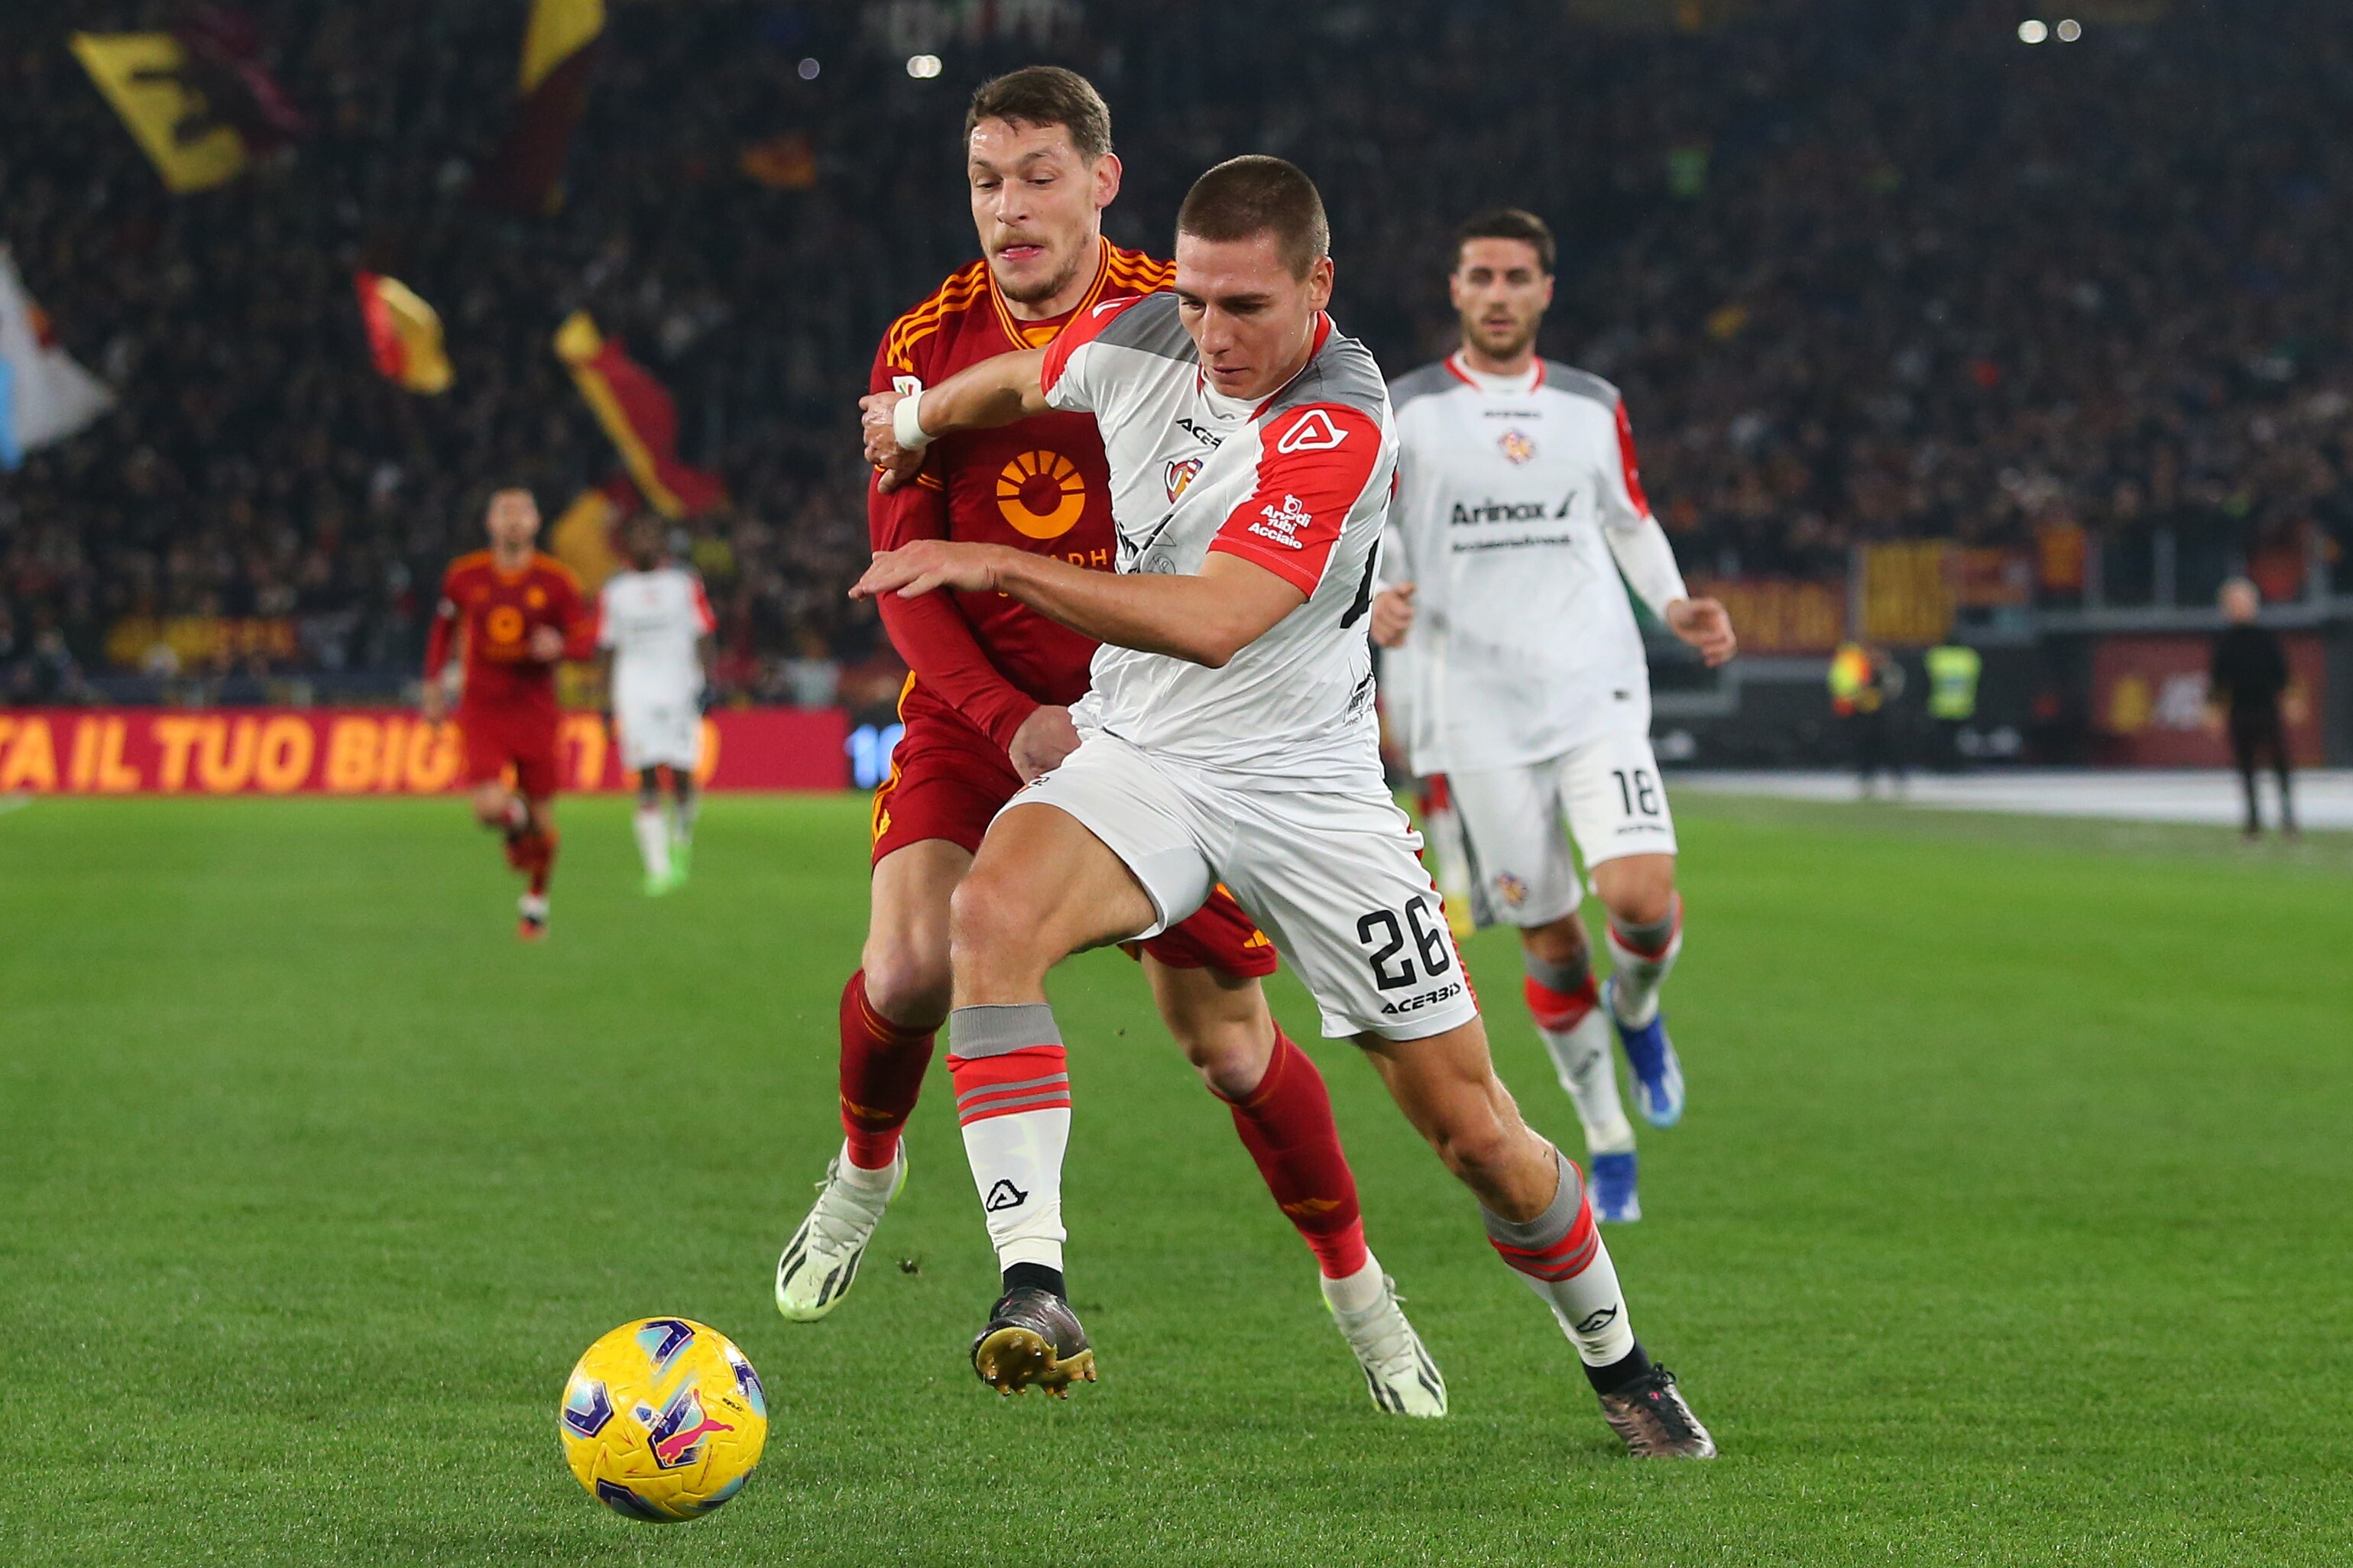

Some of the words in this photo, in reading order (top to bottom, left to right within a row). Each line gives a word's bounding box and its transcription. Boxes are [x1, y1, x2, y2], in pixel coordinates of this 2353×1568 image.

[1247, 522, 1303, 549] Acciaio
[0, 716, 59, 792] A
[72, 716, 144, 792] IL
[155, 715, 316, 793] TUO
[1612, 769, 1658, 817] 18
[1356, 896, 1450, 991] 26
